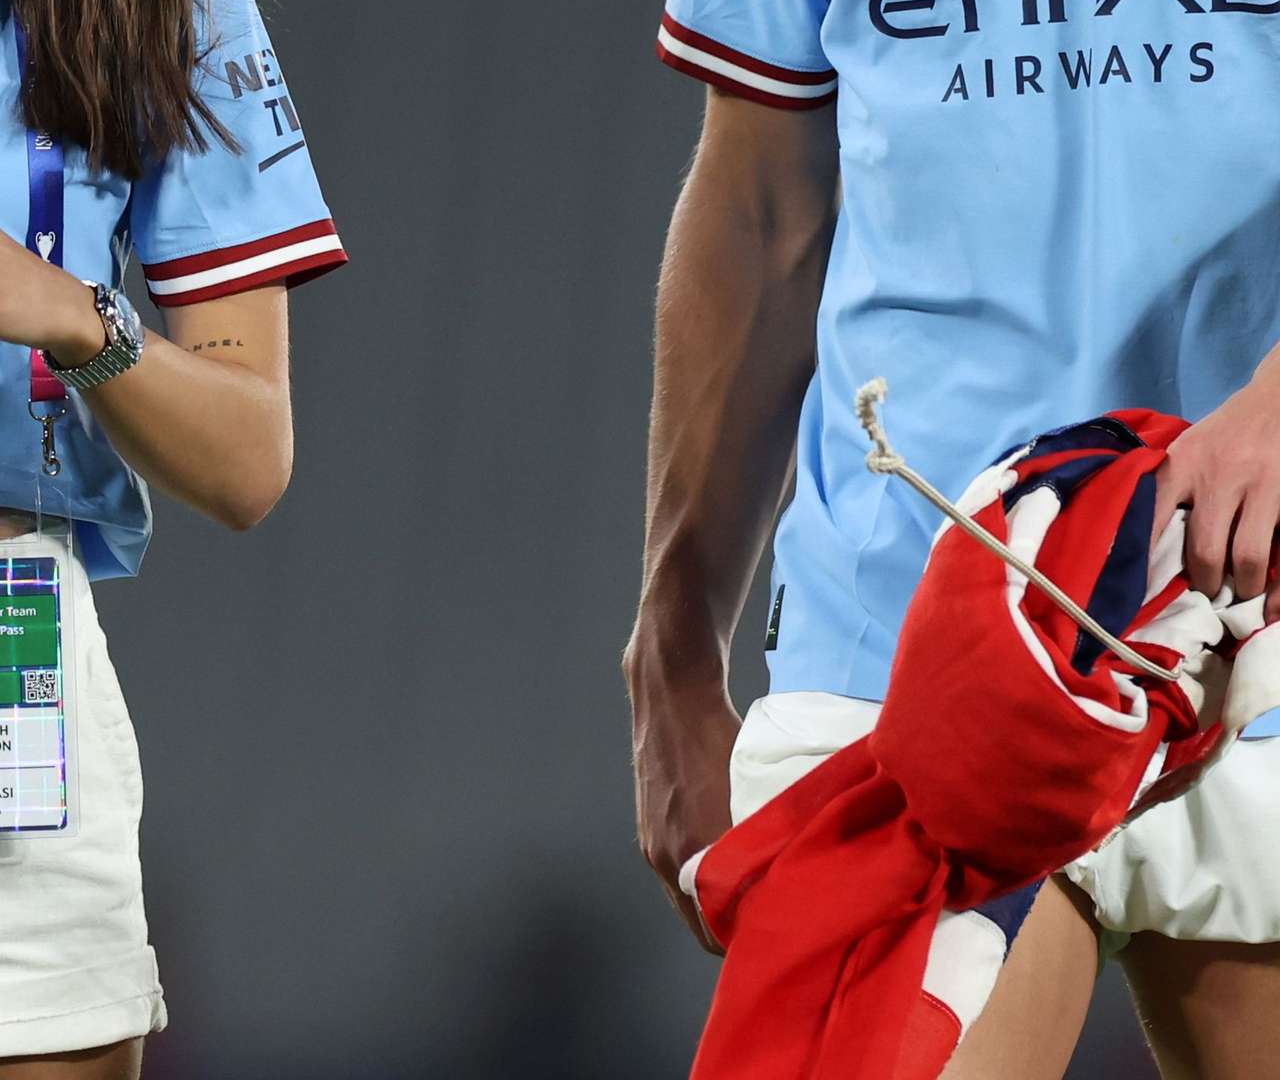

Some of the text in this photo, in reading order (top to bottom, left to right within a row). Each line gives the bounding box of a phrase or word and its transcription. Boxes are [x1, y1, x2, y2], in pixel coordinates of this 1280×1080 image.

[941, 42, 1215, 102] AIRWAYS
[263, 95, 301, 136] TI
[6, 606, 37, 617] Team
[0, 625, 24, 636] Pass
